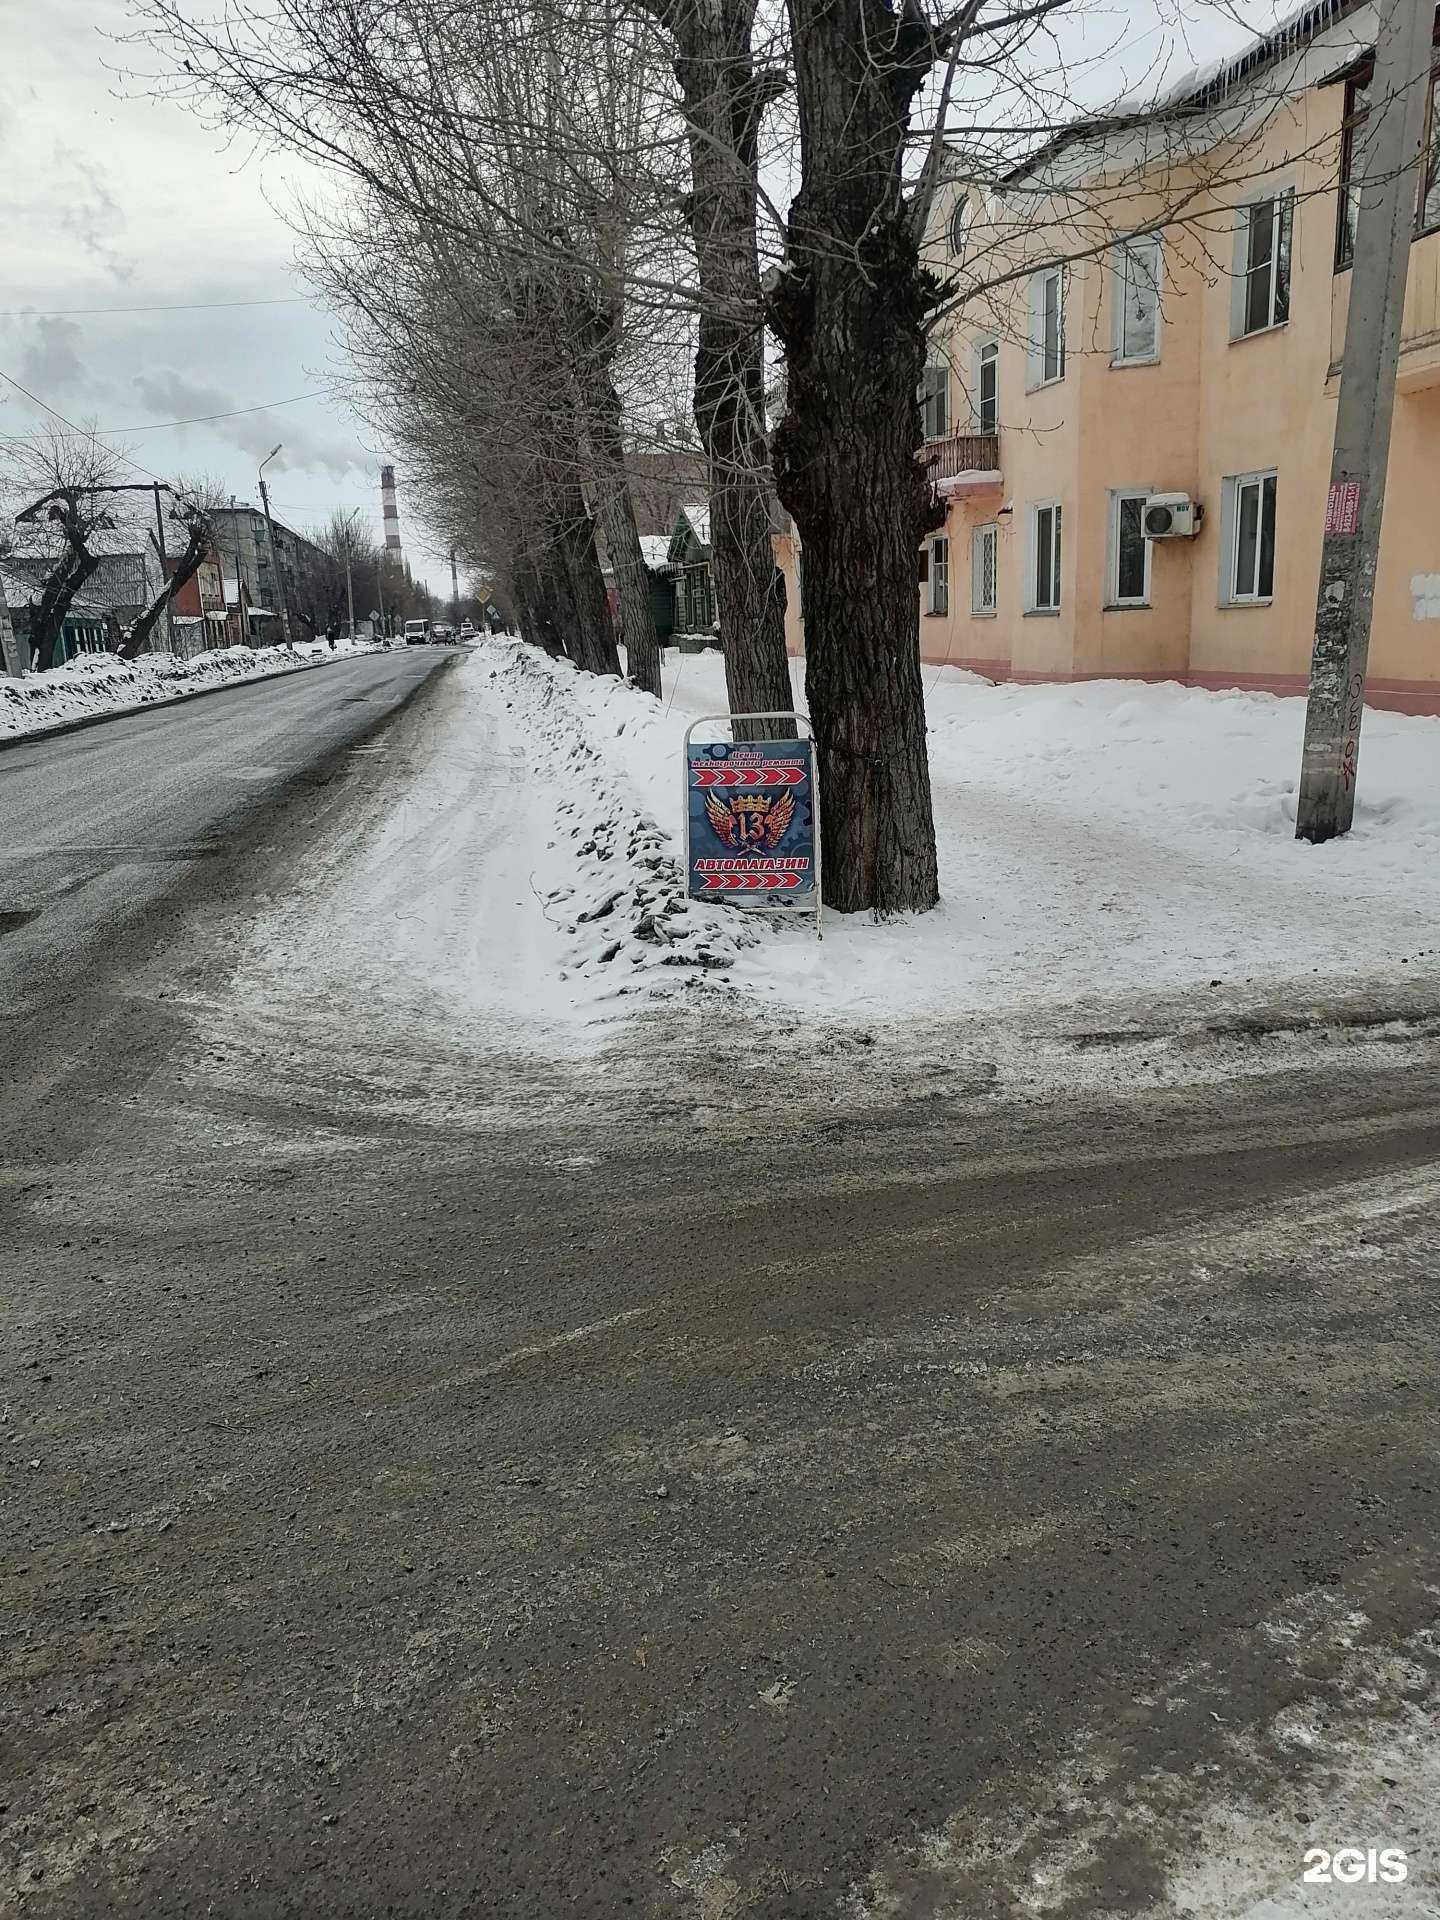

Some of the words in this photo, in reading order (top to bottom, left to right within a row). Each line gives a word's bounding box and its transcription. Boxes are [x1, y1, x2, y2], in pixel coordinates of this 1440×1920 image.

[1325, 485, 1336, 531] ПОМОЩЬ
[732, 752, 763, 760] Центр
[762, 759, 804, 768] ремонта
[738, 812, 765, 840] 13
[694, 857, 809, 871] АВТОМАГАЗИН
